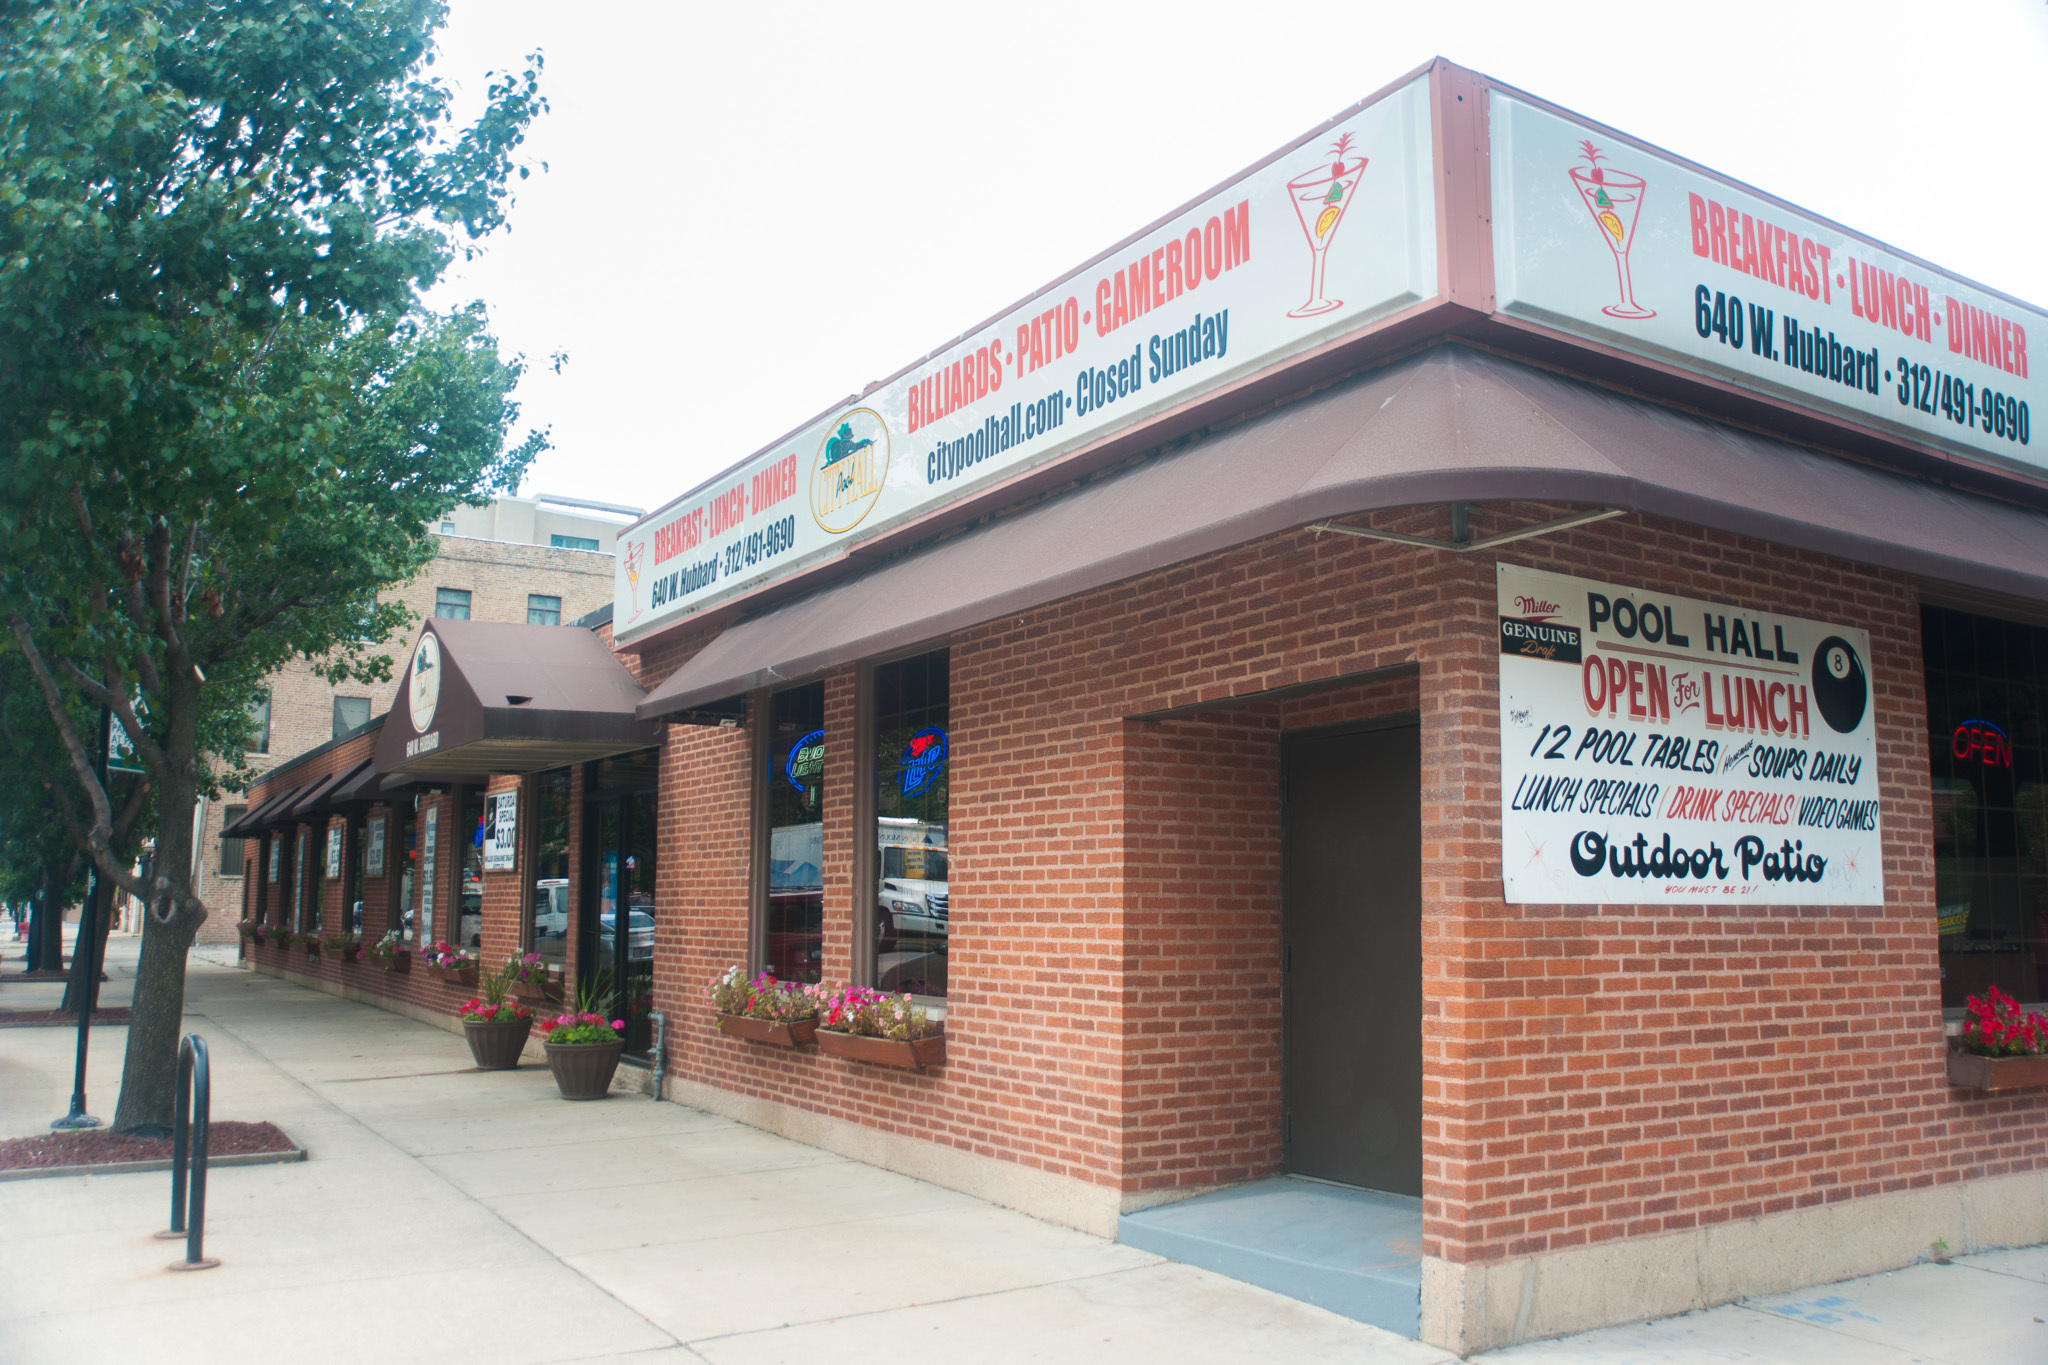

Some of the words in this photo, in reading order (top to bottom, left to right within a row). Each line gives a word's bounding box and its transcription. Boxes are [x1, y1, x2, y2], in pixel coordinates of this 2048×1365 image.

[1688, 191, 1831, 306] BREAKFAST
[1848, 256, 1931, 344] LUNCH
[1945, 295, 2029, 380] DINNER
[908, 338, 1002, 434] BILLIARDS
[1016, 296, 1079, 379] PATIO
[1095, 198, 1251, 338] GAMEROOM
[1694, 284, 1744, 350] 640
[1748, 302, 1779, 362] W.
[1783, 315, 1879, 396] Hubbard
[1897, 357, 2030, 446] 312/491-9690
[927, 389, 1064, 485] citypoolhall.com
[1076, 343, 1142, 417] Closed
[1149, 308, 1229, 384] Sunday
[654, 506, 704, 566] BREAKFAST
[709, 482, 745, 539] LUNCH
[752, 453, 797, 517] DINNER
[651, 576, 669, 610] 640
[669, 572, 679, 600] W.
[679, 552, 719, 598] Hubbard
[724, 514, 795, 578] 312/491-9690
[1502, 621, 1579, 646] GENUINE
[1514, 595, 1560, 614] Miller
[1587, 591, 1689, 648] POOL
[1703, 612, 1799, 665] HALL
[1520, 640, 1557, 659] Draft
[1834, 653, 1843, 672] 8
[1581, 654, 1671, 724] OPEN
[1671, 671, 1700, 709] For
[1702, 671, 1810, 740] LUNCH
[1530, 724, 1571, 760] 12
[1574, 727, 1637, 766] POOL
[1641, 733, 1719, 775] TABLES
[1748, 744, 1808, 781] SOUPS
[1809, 750, 1862, 785] DAILY
[1953, 726, 2011, 768] OPEN
[497, 794, 516, 809] SATURDA
[1511, 773, 1583, 813] LUNCH
[1579, 777, 1659, 818] SPECIALS
[1666, 785, 1723, 822] DRINK
[1722, 789, 1795, 826] SPECIALS
[1569, 828, 1730, 880] Outdoor
[1733, 834, 1829, 883] Patio
[1663, 885, 1687, 894] YOU
[1688, 885, 1718, 894] MUST
[1722, 885, 1738, 894] BE
[1740, 884, 1759, 895] 21!
